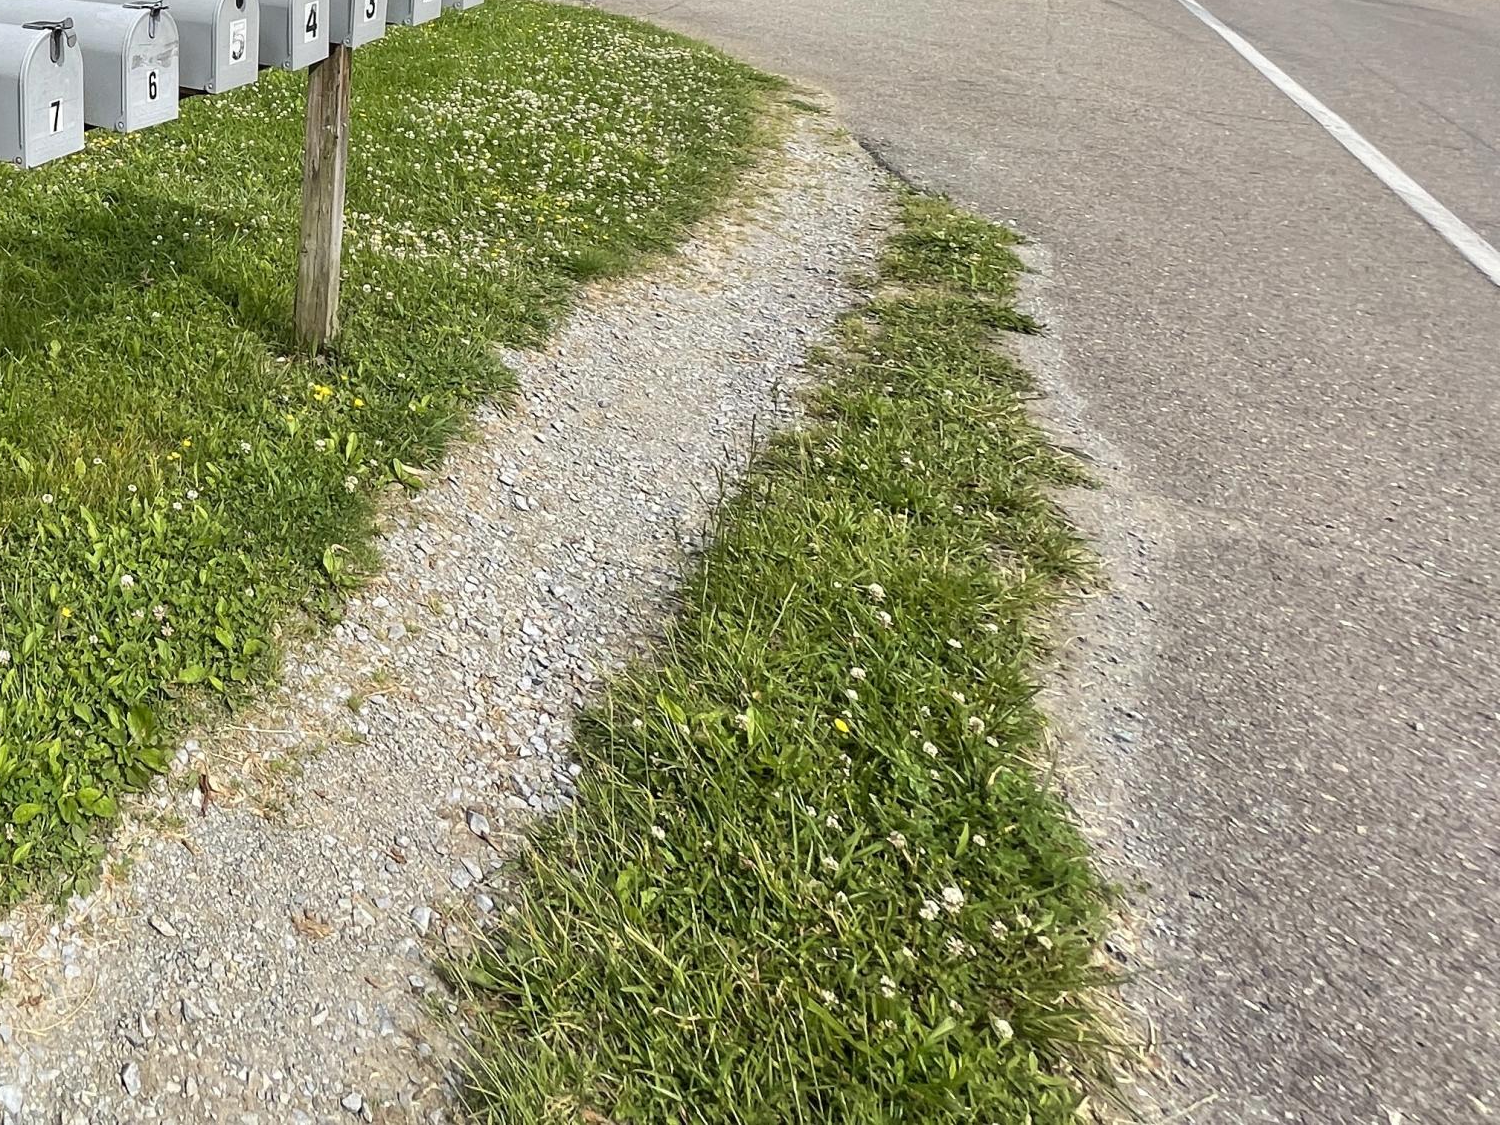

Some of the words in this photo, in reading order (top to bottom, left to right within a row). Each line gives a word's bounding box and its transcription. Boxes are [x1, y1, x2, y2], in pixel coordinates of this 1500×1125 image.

[306, 3, 318, 38] 4
[231, 21, 246, 61] 5
[148, 71, 157, 100] 6
[50, 100, 61, 132] 7
